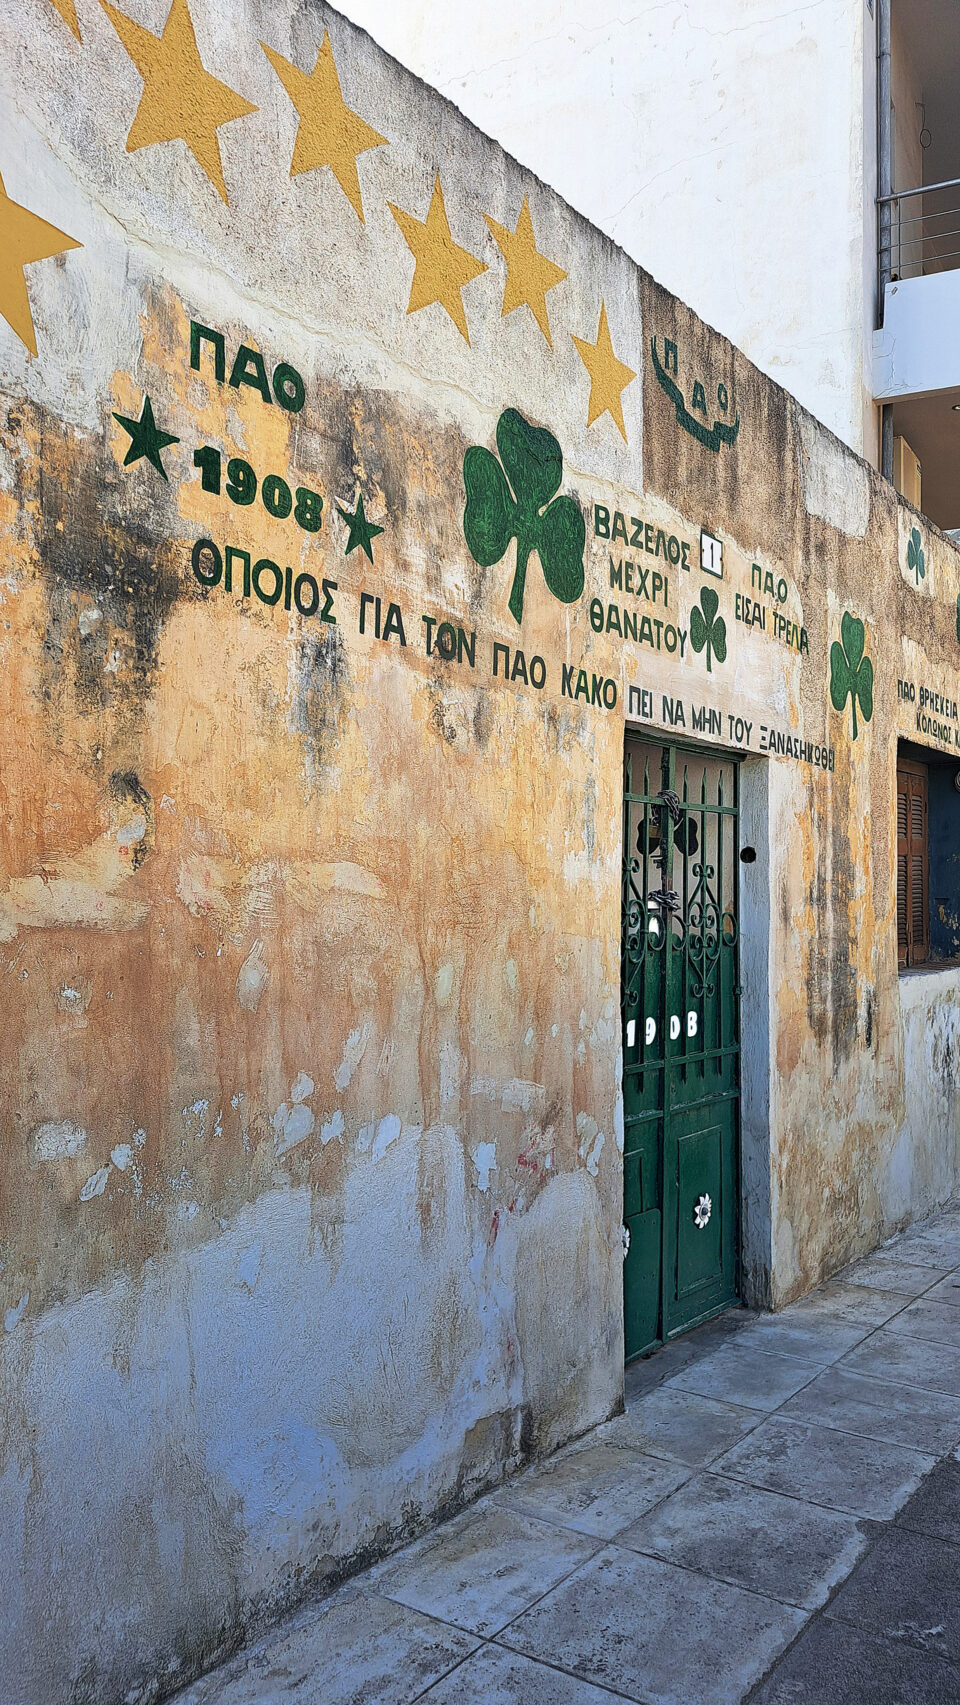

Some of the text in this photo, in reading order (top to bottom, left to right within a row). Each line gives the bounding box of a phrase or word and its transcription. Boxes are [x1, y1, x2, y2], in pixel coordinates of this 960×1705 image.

[190, 319, 306, 413] ΠΑΟ
[193, 445, 324, 532] 1908
[594, 504, 691, 572] ΒΑΖΕΛΟΣ
[609, 555, 669, 607] ΜΕΧΡΙ
[751, 563, 788, 604] ΠΑΟ
[589, 598, 688, 658] ΘΑΝΑΤΟΥ
[735, 592, 809, 656] ΕΙΣΑΙ ΤΡΕΛΑ
[191, 538, 835, 773] ΟΠΟΙΟΣ ΓΙΑ ΤΟΝ ΠΑΟ ΚΑΚΟ ΠΕΙ ΝΑ ΜΗΝ ΤΟΥ ΞΑΝΑΣΗΚΩΘΕΙ
[897, 679, 915, 702] ΠΑΟ
[626, 1010, 698, 1047] 1908
